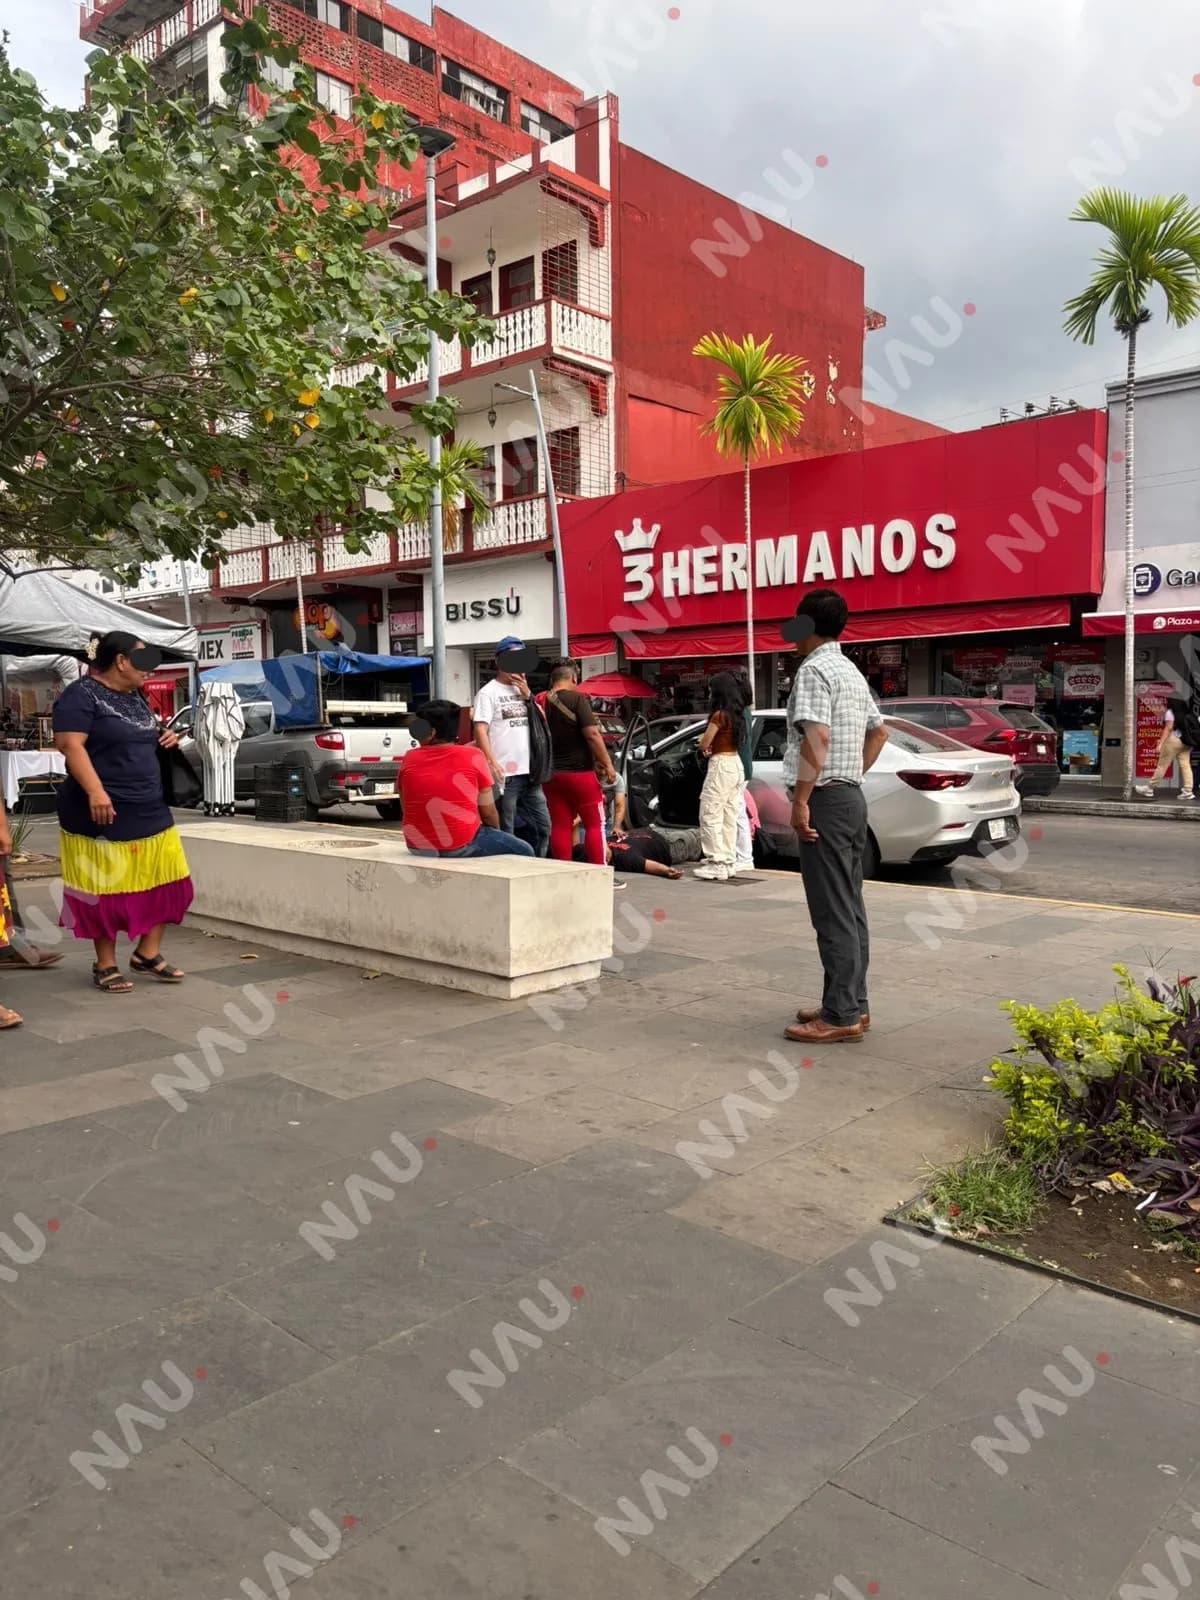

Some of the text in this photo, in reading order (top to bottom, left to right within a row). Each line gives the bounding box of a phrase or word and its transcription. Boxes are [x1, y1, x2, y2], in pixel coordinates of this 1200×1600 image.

[622, 513, 957, 602] 3 HERMANOS
[1166, 568, 1200, 588] Ga
[1167, 617, 1193, 626] Plaza
[233, 638, 254, 652] MEX
